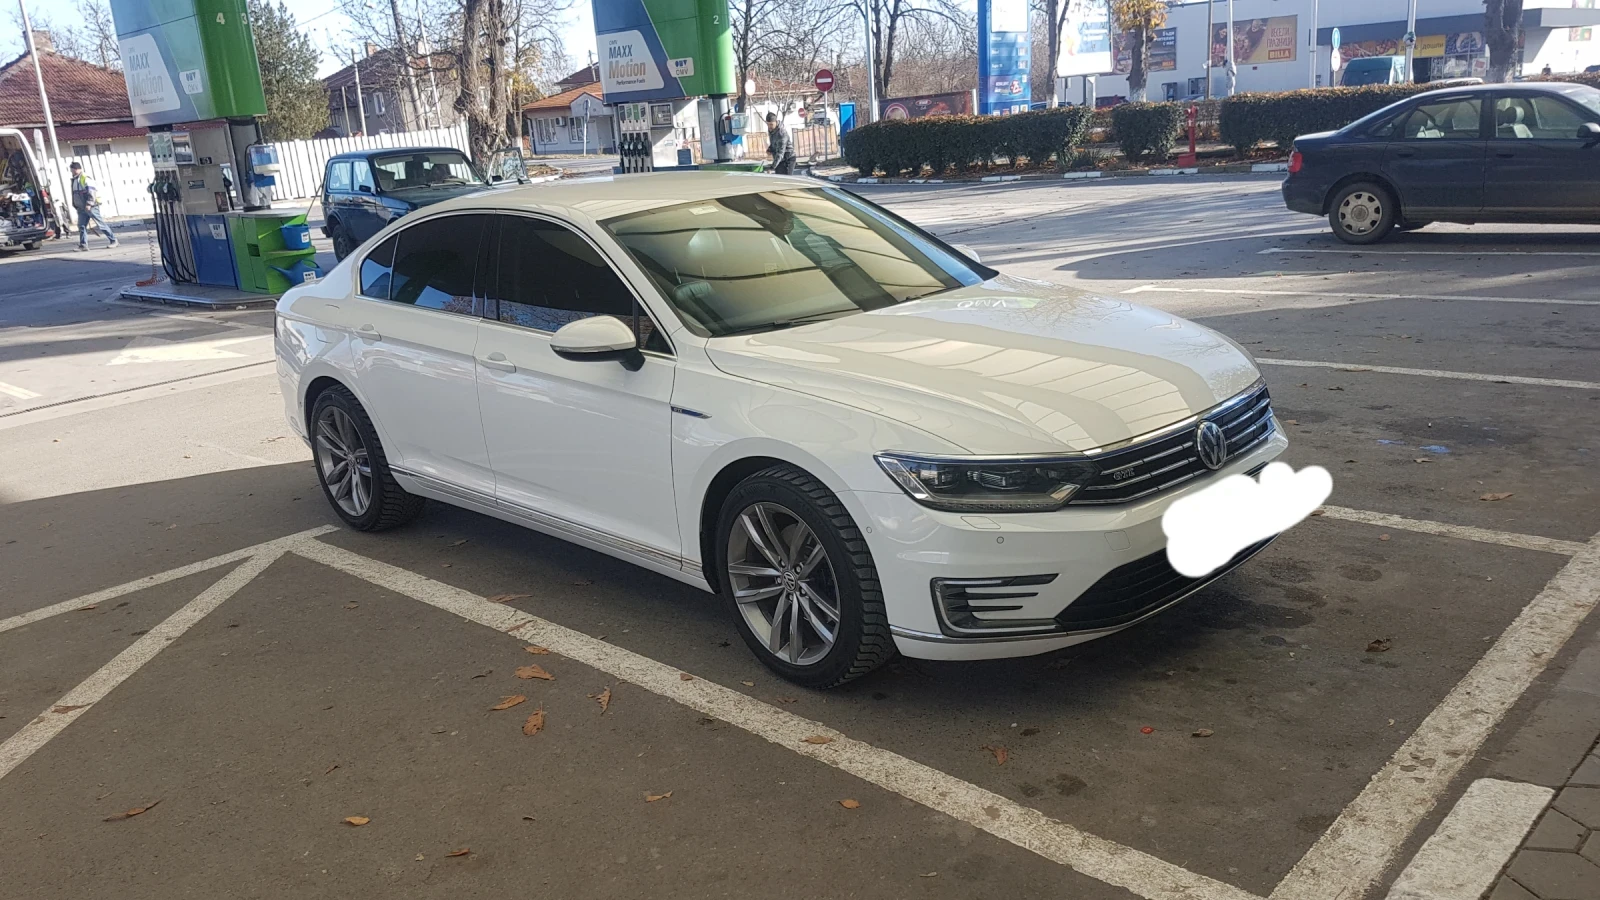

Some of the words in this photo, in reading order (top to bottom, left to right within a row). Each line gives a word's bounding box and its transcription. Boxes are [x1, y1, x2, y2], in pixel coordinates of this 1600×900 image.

[216, 12, 225, 25] 4
[241, 12, 248, 25] 3
[713, 15, 719, 24] 2
[608, 44, 633, 60] MAXX
[1269, 50, 1290, 59] BILLA
[129, 51, 150, 72] MAXX
[608, 58, 646, 79] Motion
[131, 70, 164, 97] Motion
[1113, 468, 1136, 481] GTE
